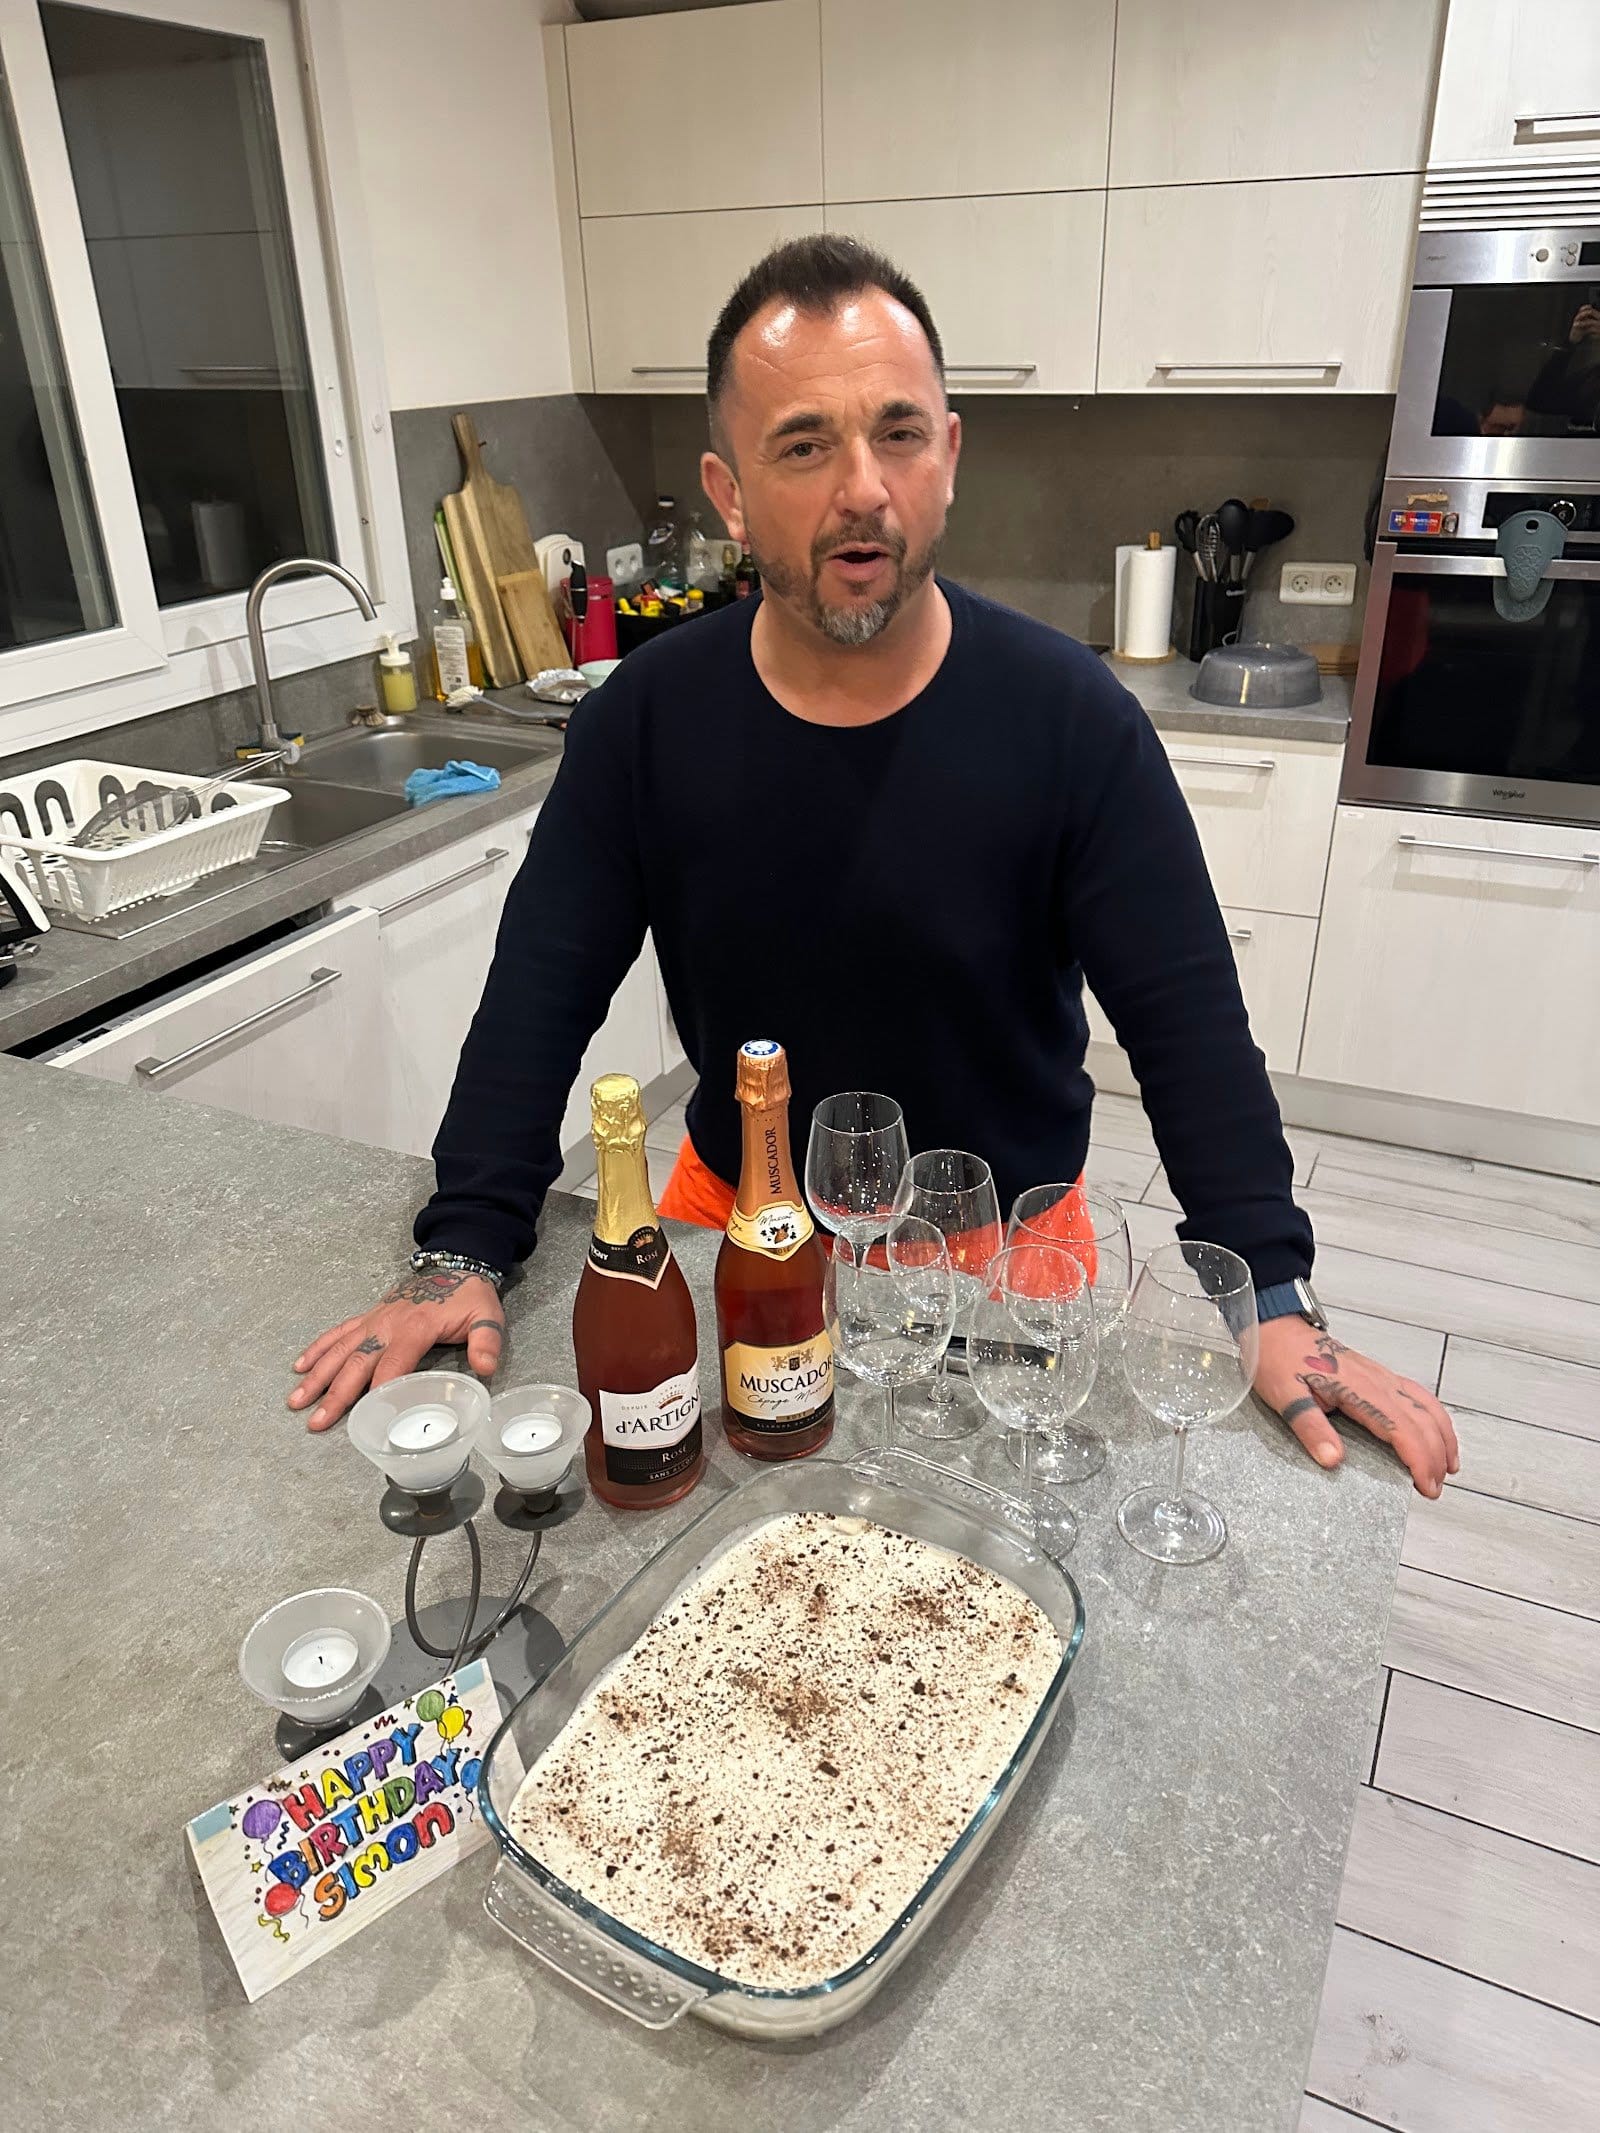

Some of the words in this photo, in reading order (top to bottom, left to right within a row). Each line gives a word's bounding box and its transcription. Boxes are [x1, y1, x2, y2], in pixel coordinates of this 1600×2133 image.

[764, 1126, 783, 1195] MUSCADOR
[739, 1353, 833, 1394] MUSCADOR
[615, 1384, 701, 1435] d'ARTIGN
[282, 1722, 424, 1832] HAPPY
[268, 1748, 462, 1890] BIRTHDAY
